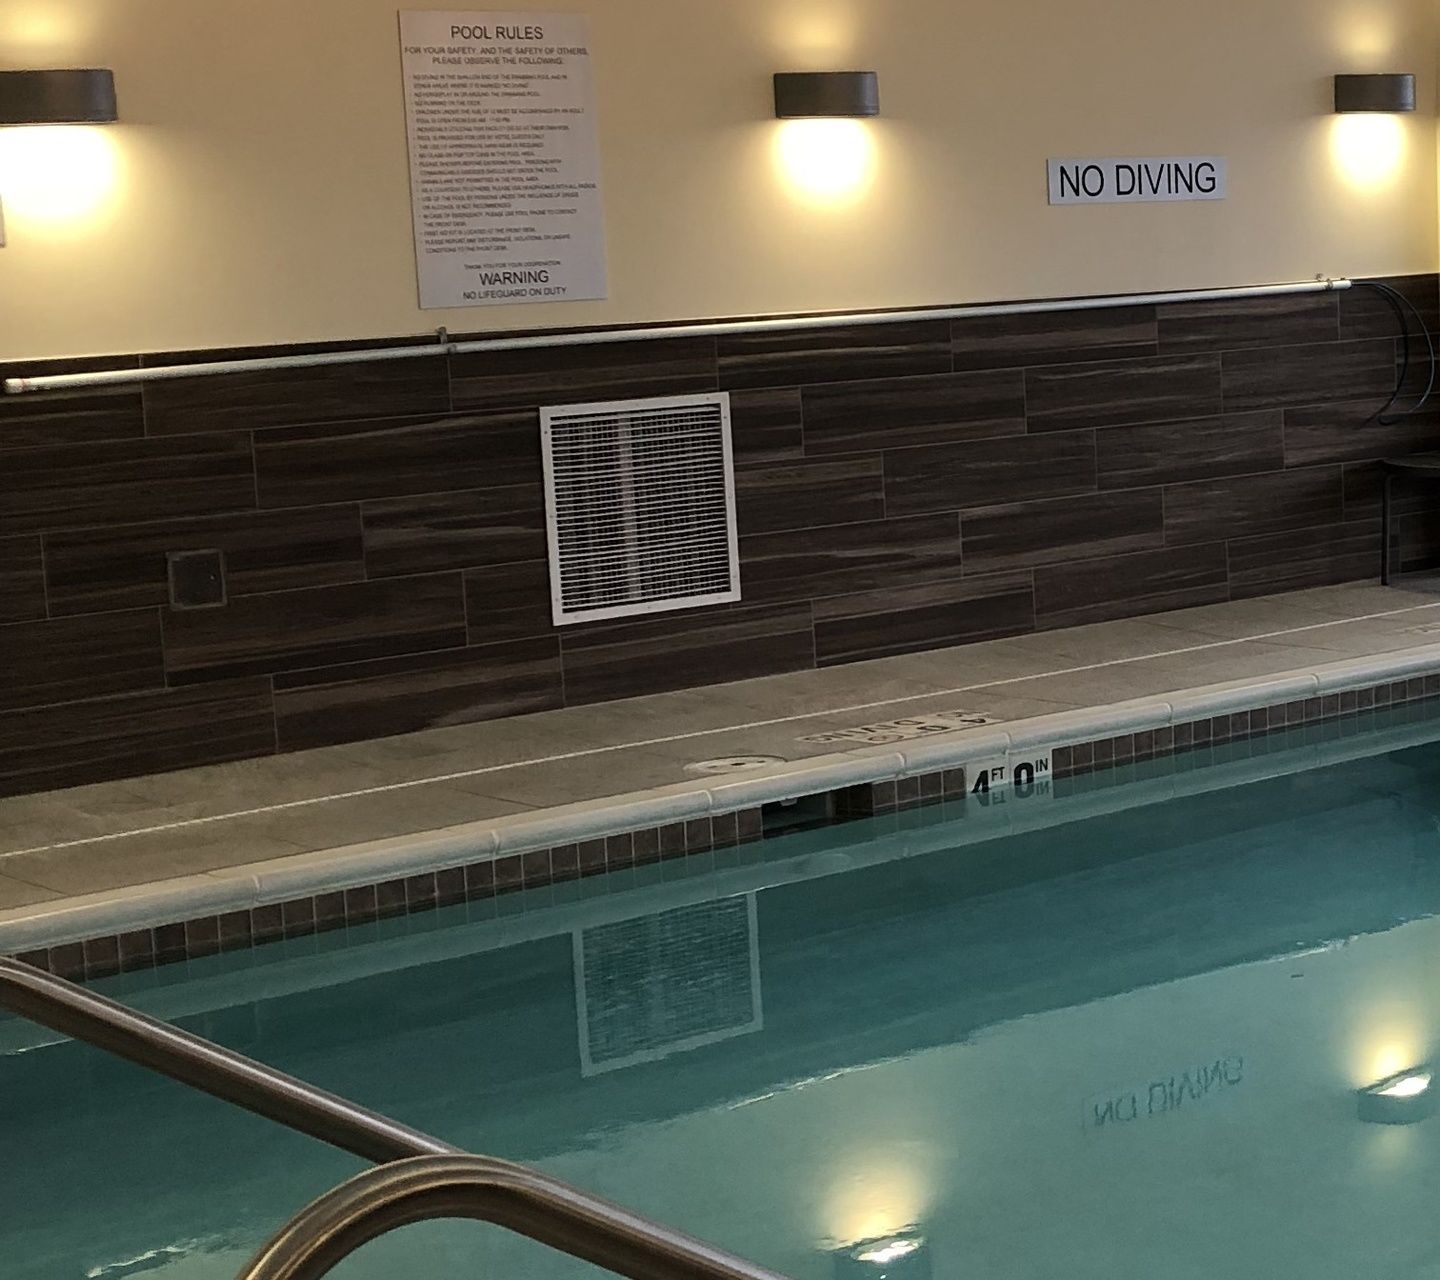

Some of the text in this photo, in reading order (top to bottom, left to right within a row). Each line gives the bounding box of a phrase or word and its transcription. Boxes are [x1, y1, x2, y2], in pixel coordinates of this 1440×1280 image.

[450, 25, 544, 40] POOL RULES
[423, 47, 445, 55] YOUR
[480, 47, 496, 55] AND
[498, 47, 513, 55] THE
[515, 47, 543, 55] SAFETY
[502, 57, 517, 65] THE
[1059, 162, 1216, 198] NO DIVING
[479, 270, 549, 286] WARNING
[463, 286, 568, 300] NO LIFEGUARD ON DUTY
